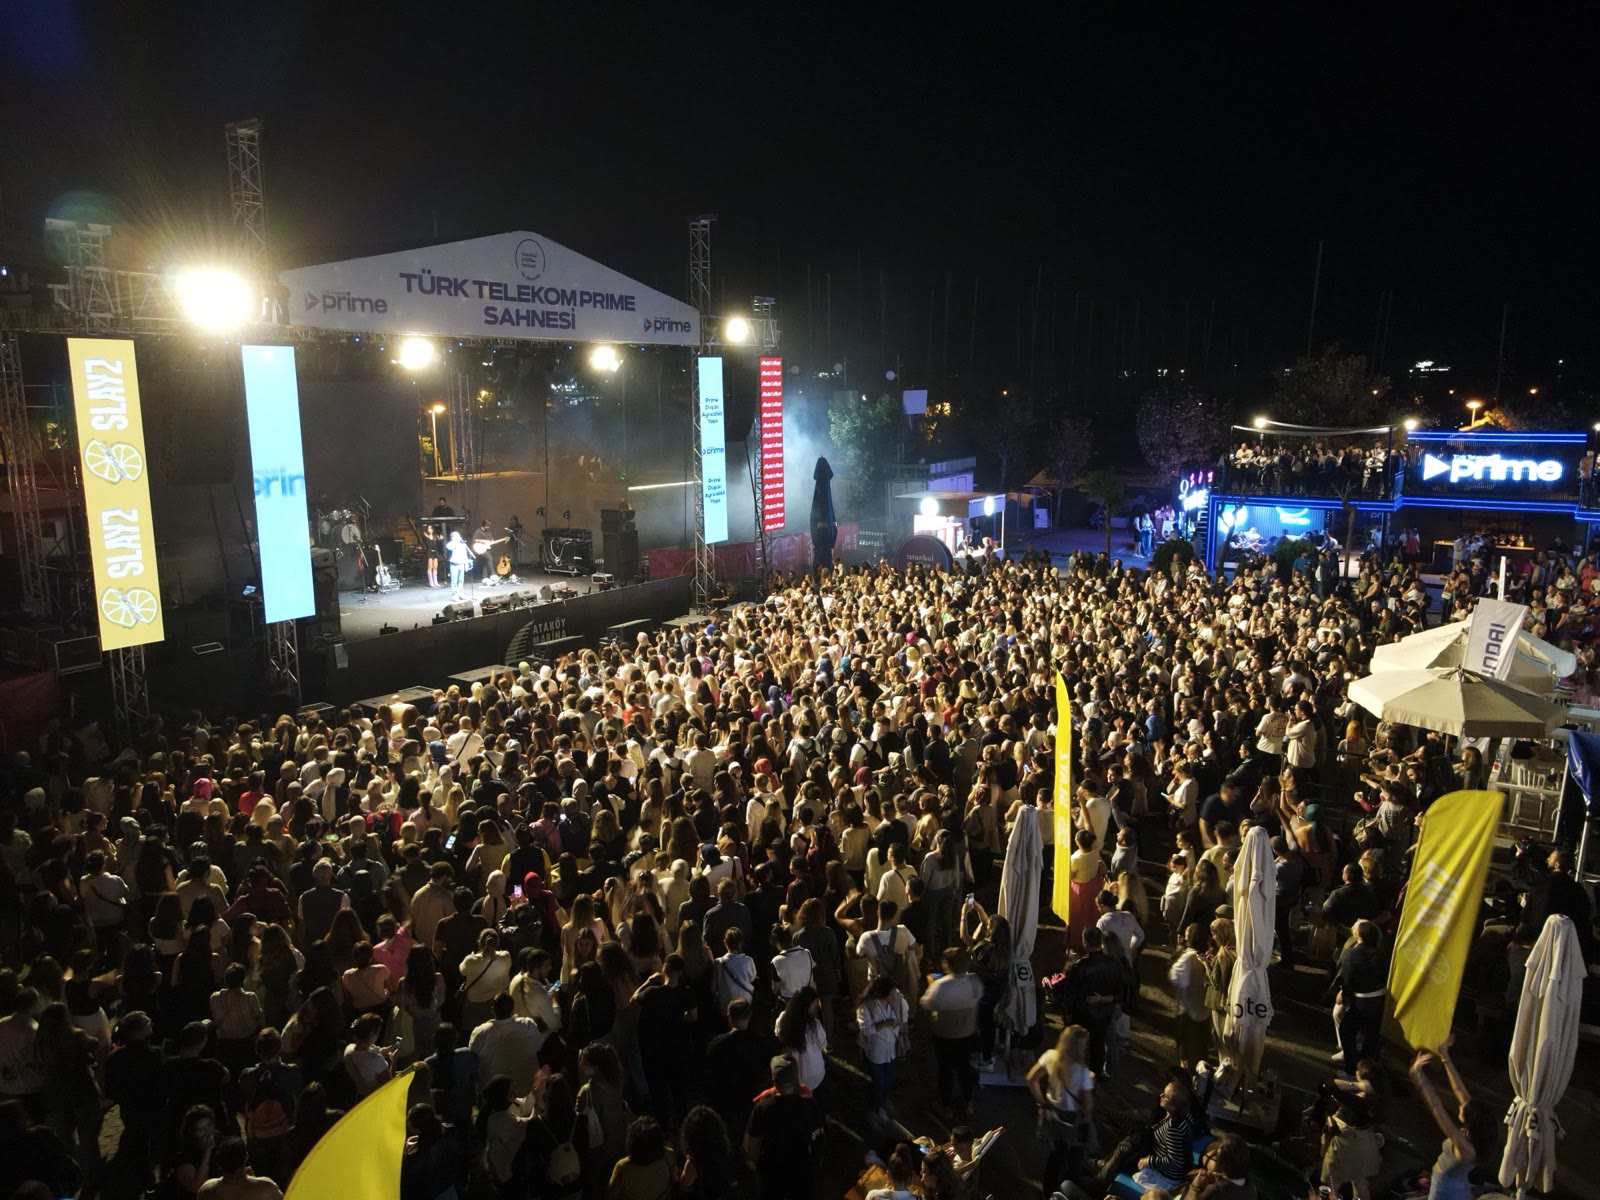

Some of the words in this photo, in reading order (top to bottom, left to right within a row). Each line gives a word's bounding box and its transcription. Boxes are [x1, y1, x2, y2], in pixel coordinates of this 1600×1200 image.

[400, 268, 470, 299] TÜRK
[472, 280, 577, 307] TELEKOM
[579, 290, 636, 312] PRIME
[322, 292, 388, 314] prime
[484, 306, 576, 330] SAHNESİ
[653, 318, 691, 334] prime
[707, 447, 725, 455] prime
[1450, 454, 1562, 483] prime
[533, 617, 566, 635] ATAKÖY
